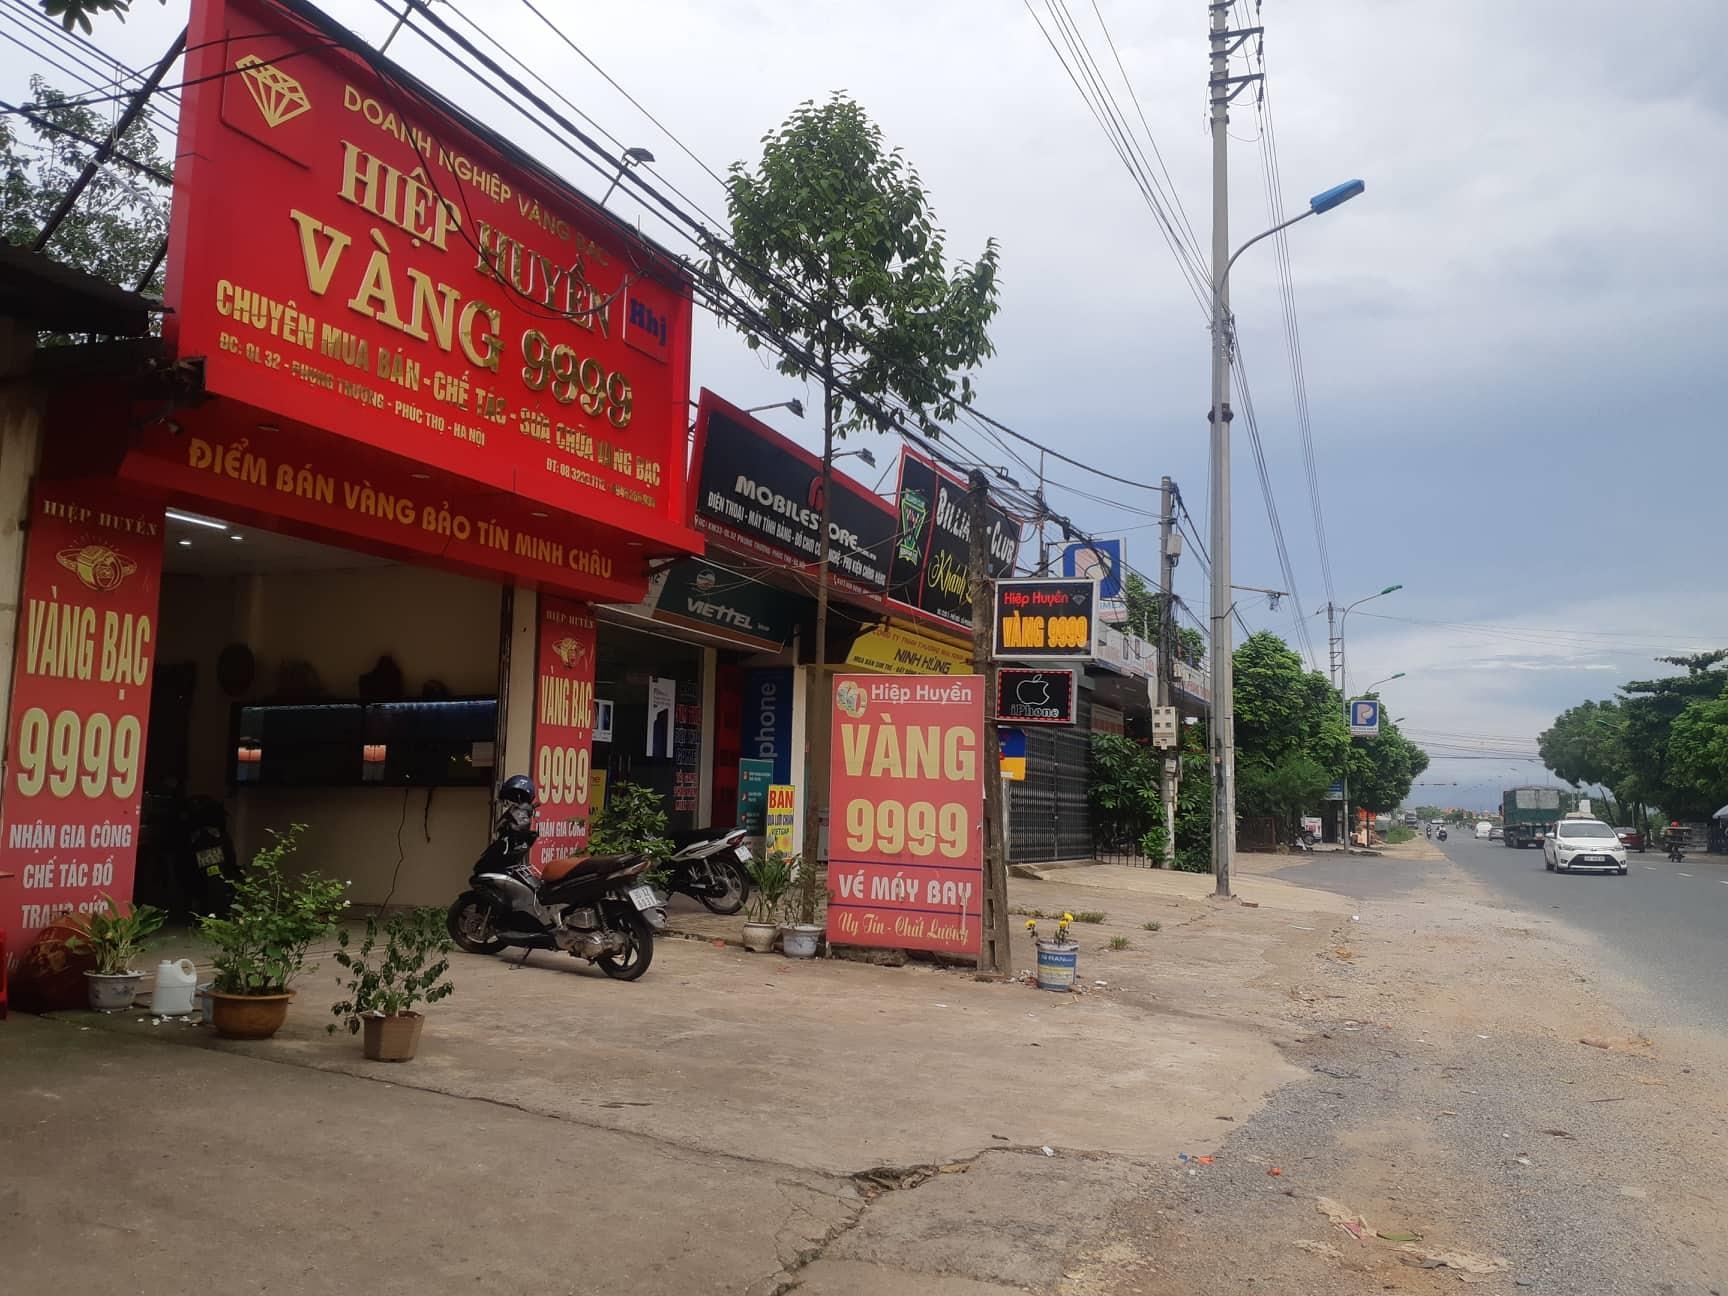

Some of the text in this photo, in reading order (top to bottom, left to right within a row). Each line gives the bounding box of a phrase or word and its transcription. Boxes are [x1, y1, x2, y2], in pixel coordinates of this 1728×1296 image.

[344, 84, 431, 158] DOANH
[439, 148, 511, 203] NGHIỆP
[518, 193, 570, 240] VÀNG
[337, 140, 609, 340] HIỆP HUYỀN
[289, 209, 632, 429] VÀNG 9999
[216, 279, 316, 350] CHUYÊN
[321, 323, 370, 373] MUA
[377, 346, 420, 393] BÁN
[433, 370, 470, 411] CHẾ
[475, 386, 506, 424] TÁC
[520, 401, 551, 443] SỬA
[556, 422, 594, 461] CHỮA
[597, 441, 632, 476] VÀNG
[636, 455, 661, 487] BẠC
[264, 350, 281, 370] 32
[292, 361, 334, 391] PHỤNG
[395, 401, 423, 425] PHÚC
[425, 412, 445, 435] THỌ
[453, 422, 467, 439] HÀ
[468, 426, 485, 447] NỘI
[43, 499, 92, 524] HIỆP
[188, 438, 612, 579] ĐIỂM BÁN VÀNG BẢO TÍN MINH CHÂU
[708, 491, 725, 513] ĐIỆN
[725, 499, 745, 523] THOẠI
[748, 510, 763, 529] MÁY
[763, 515, 777, 536] TÍNH
[776, 520, 792, 543] BẢNG
[735, 475, 858, 548] MOBILESORE
[991, 520, 1015, 565] CLUB
[927, 549, 967, 599] Khánh
[1003, 589, 1069, 607] Hiệp Huyền
[26, 585, 151, 700] VÀNG BẠC
[1002, 609, 1045, 648] VÀNG
[1047, 616, 1088, 648] 9999
[894, 648, 921, 668] NINH
[541, 665, 592, 740] VÀNG BẠC
[871, 682, 972, 705] Hiệp Huyền
[16, 707, 141, 798] 9999
[841, 713, 976, 781] VÀNG
[538, 745, 589, 804] 9999
[769, 787, 794, 809] BÁN
[9, 819, 132, 853] NHẬN GIA CÔNG
[556, 820, 567, 837] GIA
[846, 798, 968, 858] 9999
[23, 856, 57, 888] CHẾ
[59, 858, 89, 887] TÁC
[839, 870, 972, 906] VÉ MÁY BAY
[838, 912, 858, 936] Uy
[863, 913, 885, 934] Tín
[895, 916, 924, 938] Chất
[927, 920, 968, 946] Lượng
